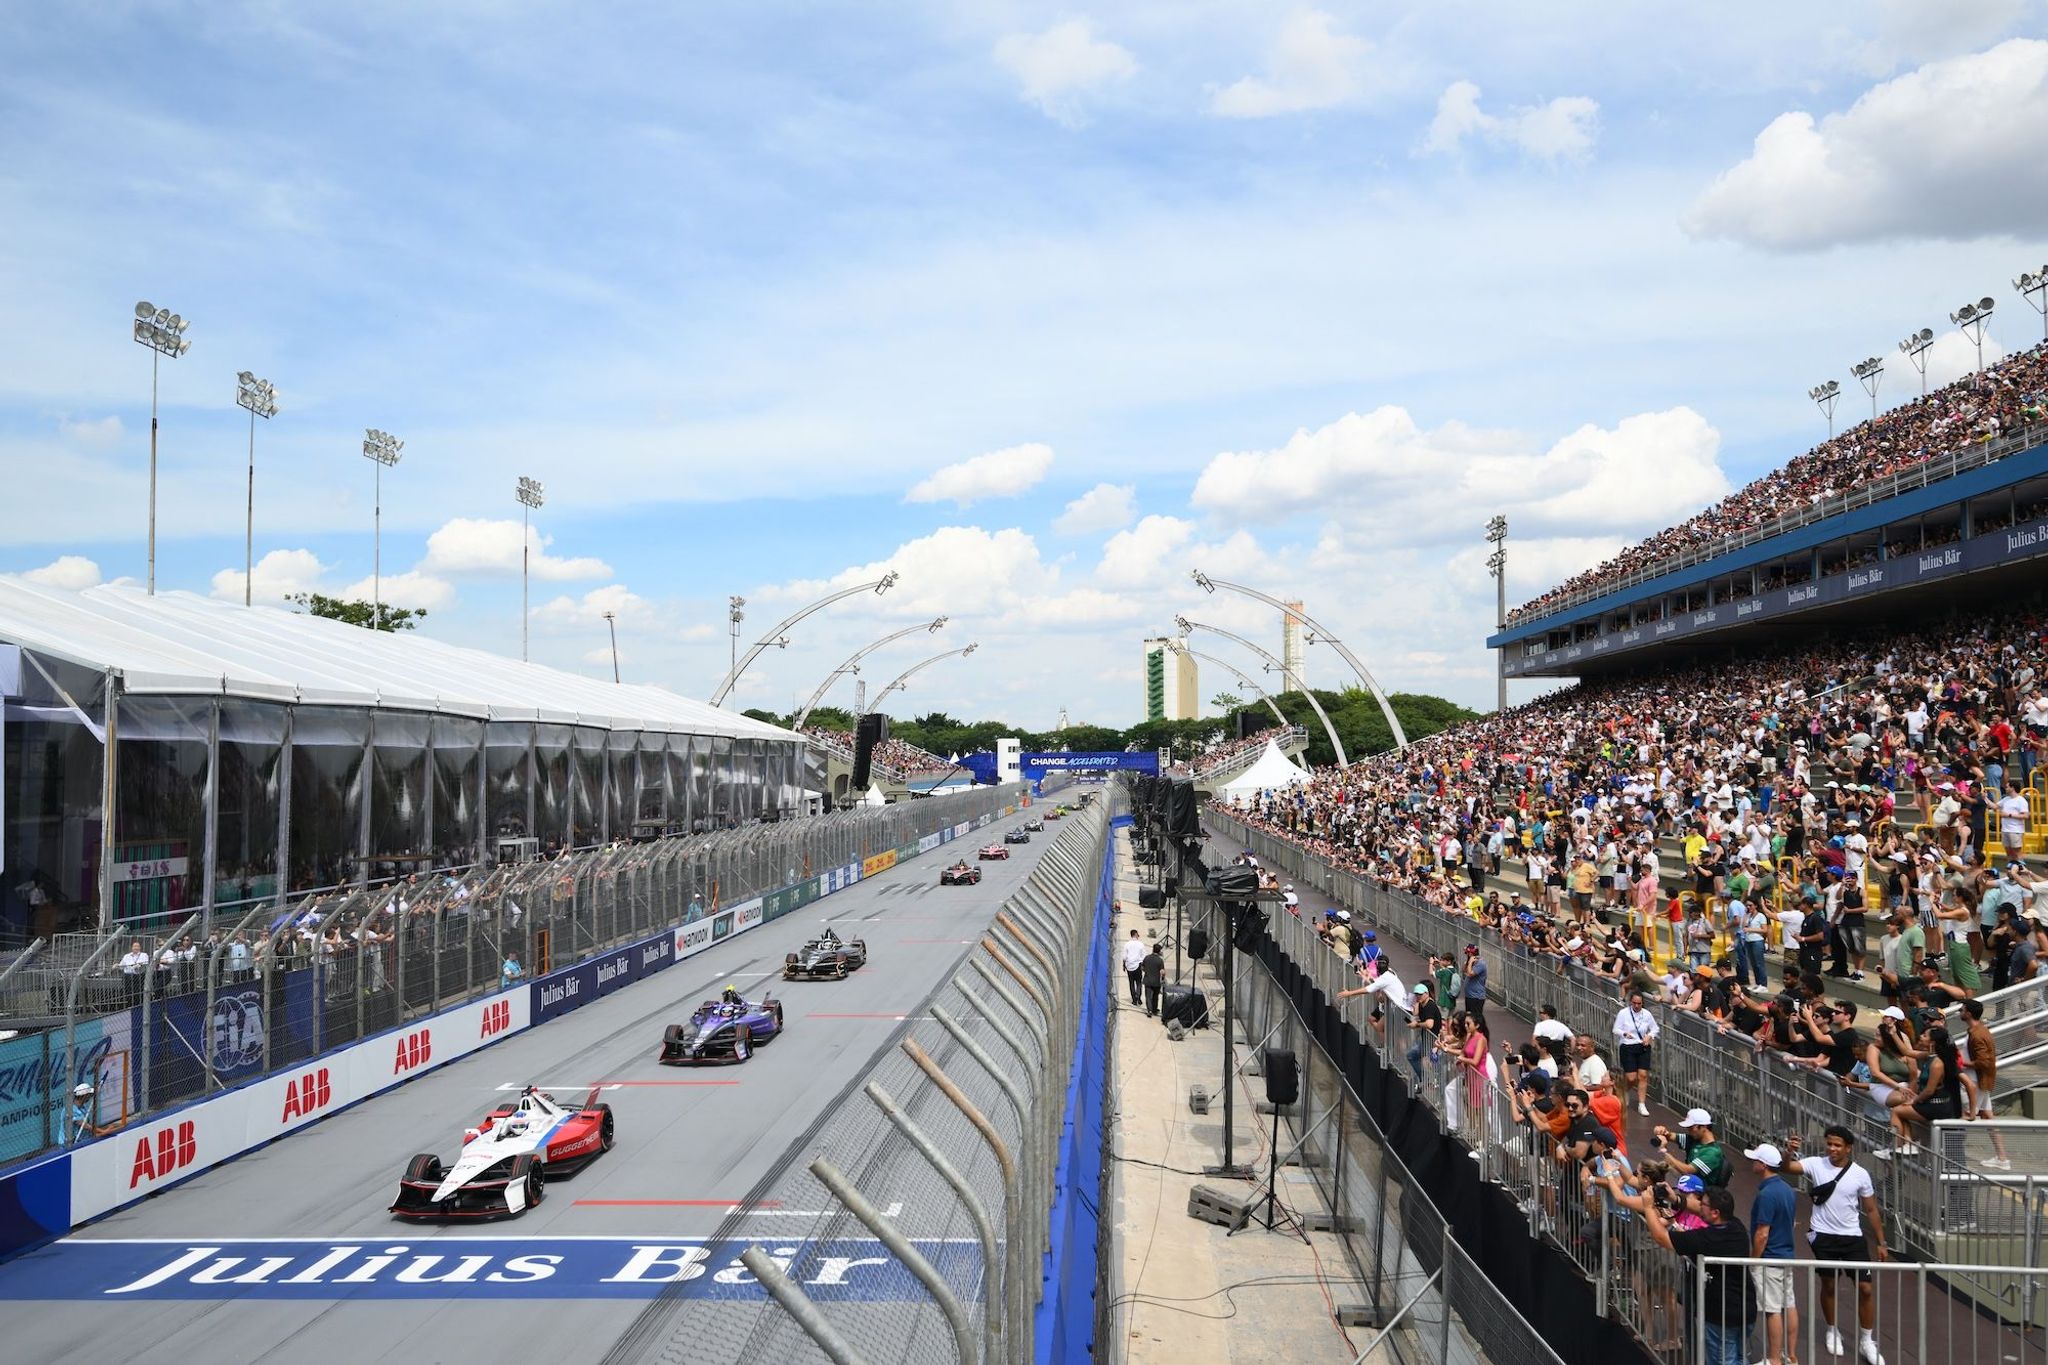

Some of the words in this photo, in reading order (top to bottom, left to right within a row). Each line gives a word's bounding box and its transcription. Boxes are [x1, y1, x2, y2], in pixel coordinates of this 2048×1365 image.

[2008, 531, 2036, 553] Julius
[2039, 525, 2048, 541] B
[1919, 555, 1943, 575] Julius
[1945, 549, 1962, 566] Bär
[1848, 573, 1868, 591] Julius
[1869, 569, 1883, 583] Bär
[1737, 604, 1751, 618] Julius
[1787, 589, 1805, 606] Julius
[1806, 586, 1818, 599] Bär
[643, 947, 659, 968] Julius
[660, 941, 669, 957] Bär
[597, 963, 616, 988] Julius
[617, 957, 629, 976] Bär
[541, 983, 564, 1012] Julius
[565, 976, 580, 997] Bär
[481, 1000, 509, 1039] ABB
[394, 1029, 431, 1075] ABB
[282, 1068, 331, 1123] ABB
[1, 1097, 64, 1127] AMPIOSH
[129, 1120, 196, 1189] ABB
[104, 1246, 564, 1294] Julius
